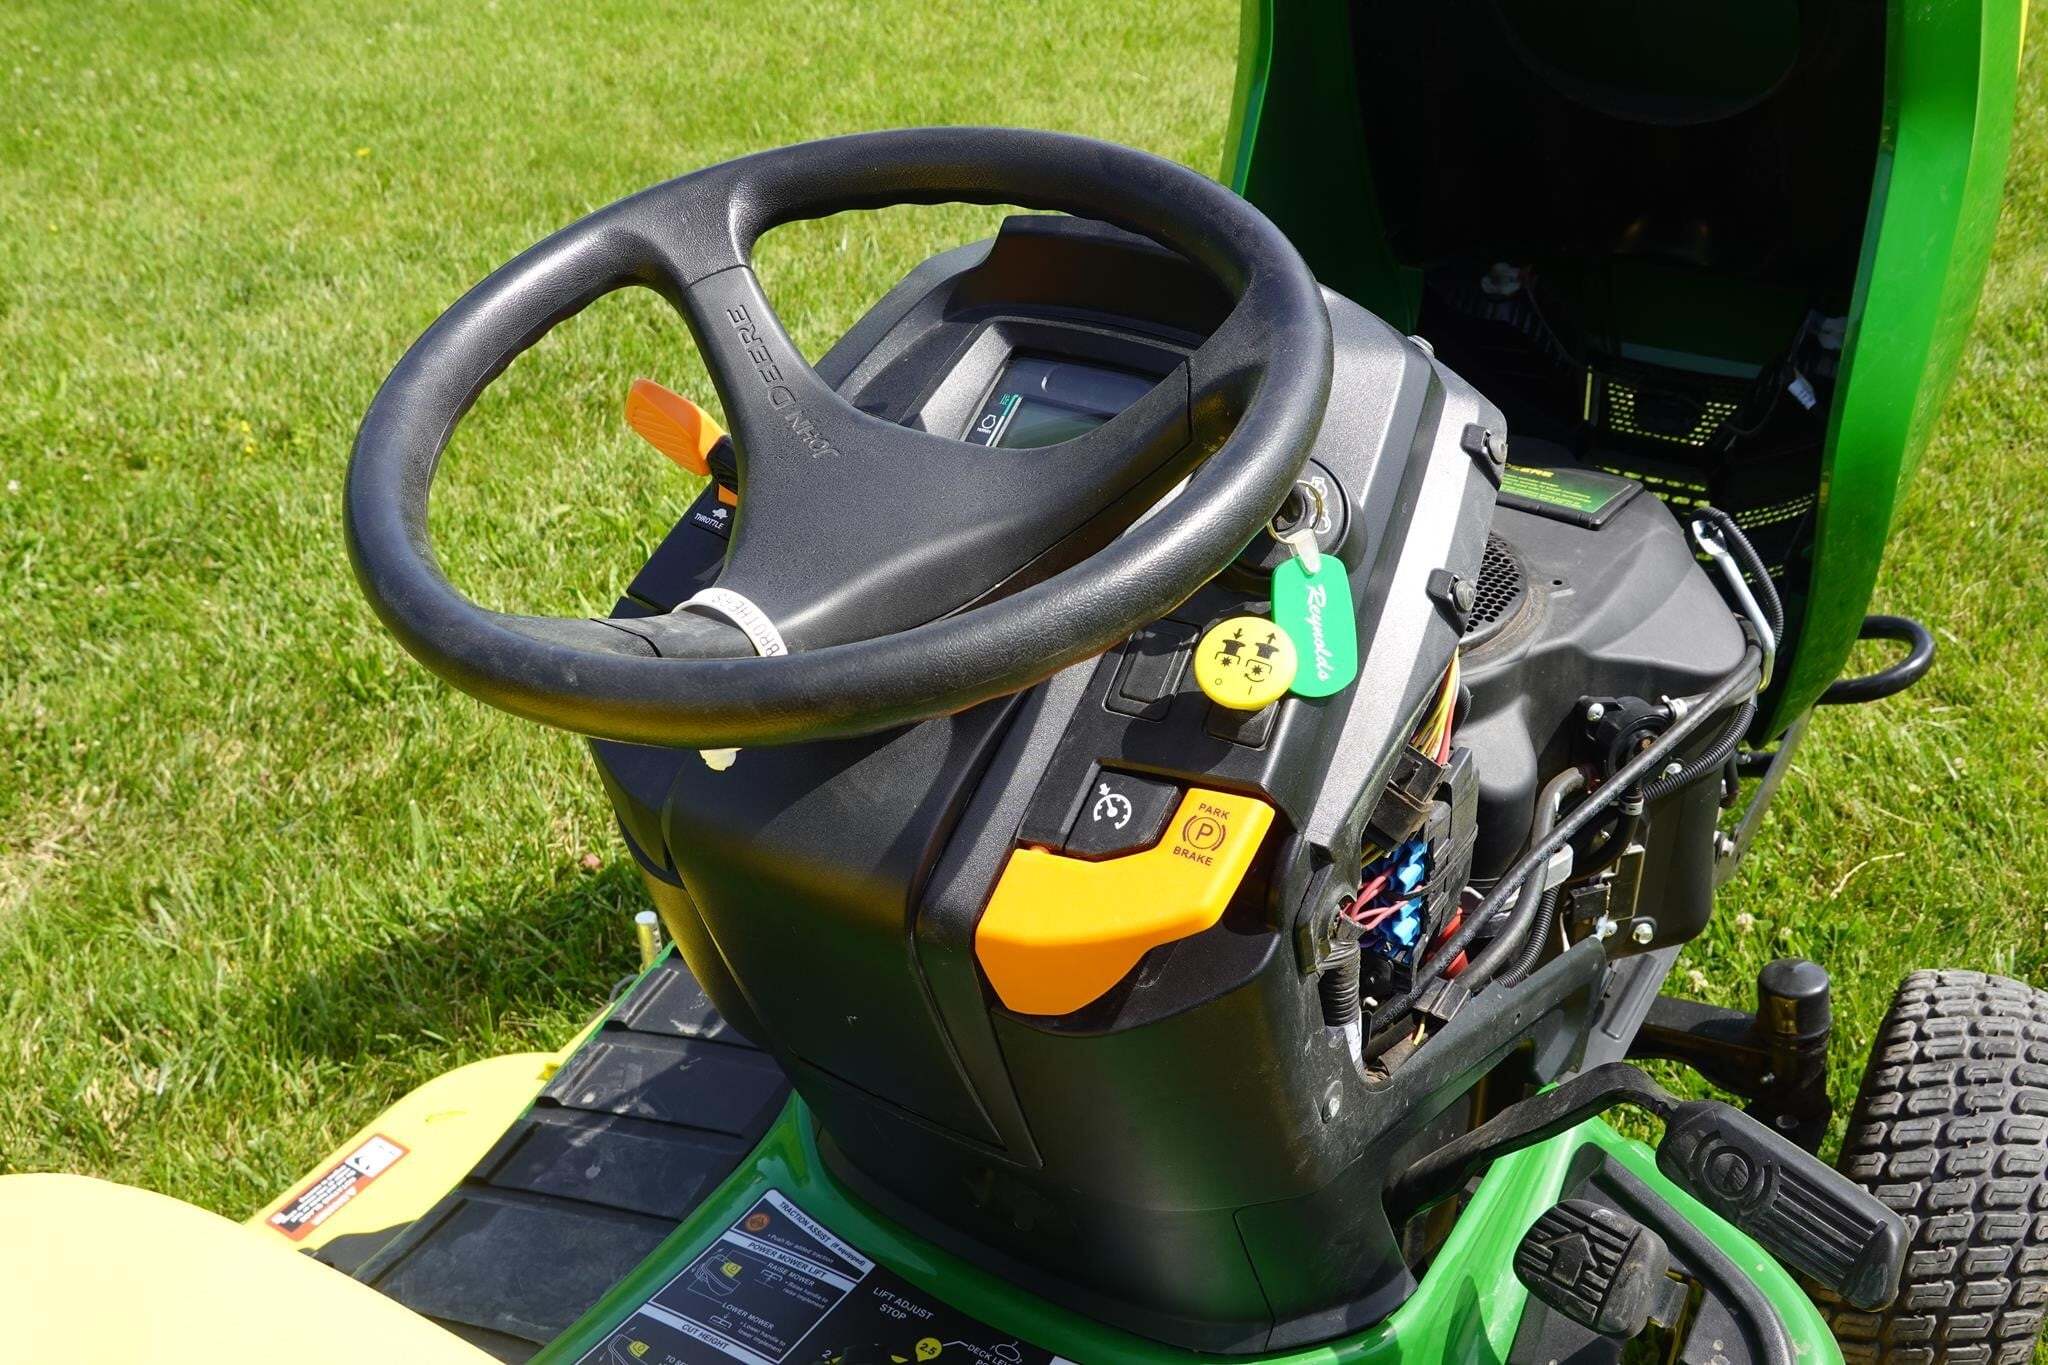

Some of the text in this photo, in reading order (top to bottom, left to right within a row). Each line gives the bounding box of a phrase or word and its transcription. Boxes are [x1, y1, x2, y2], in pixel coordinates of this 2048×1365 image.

[726, 304, 840, 459] JOHN DEERE
[694, 512, 725, 529] THROTTLE
[1304, 583, 1335, 682] Reynolds
[1198, 802, 1230, 821] PARK
[1195, 823, 1214, 841] P
[1172, 846, 1214, 866] BRAKE
[779, 1201, 809, 1227] TRACTION
[807, 1223, 832, 1243] ASSIST
[838, 1245, 866, 1267] equipped)
[748, 1242, 827, 1278] POWER MOWER LIFT
[767, 1262, 815, 1287] RAISE MOWER
[872, 1287, 934, 1320] LIFT ADJUST
[879, 1303, 907, 1320] STOP
[722, 1302, 775, 1330] LOWER MOWER
[681, 1323, 730, 1350] CUT HEIGHT
[822, 1349, 833, 1359] 2
[919, 1342, 938, 1355] 2.5
[967, 1343, 993, 1361] DECK
